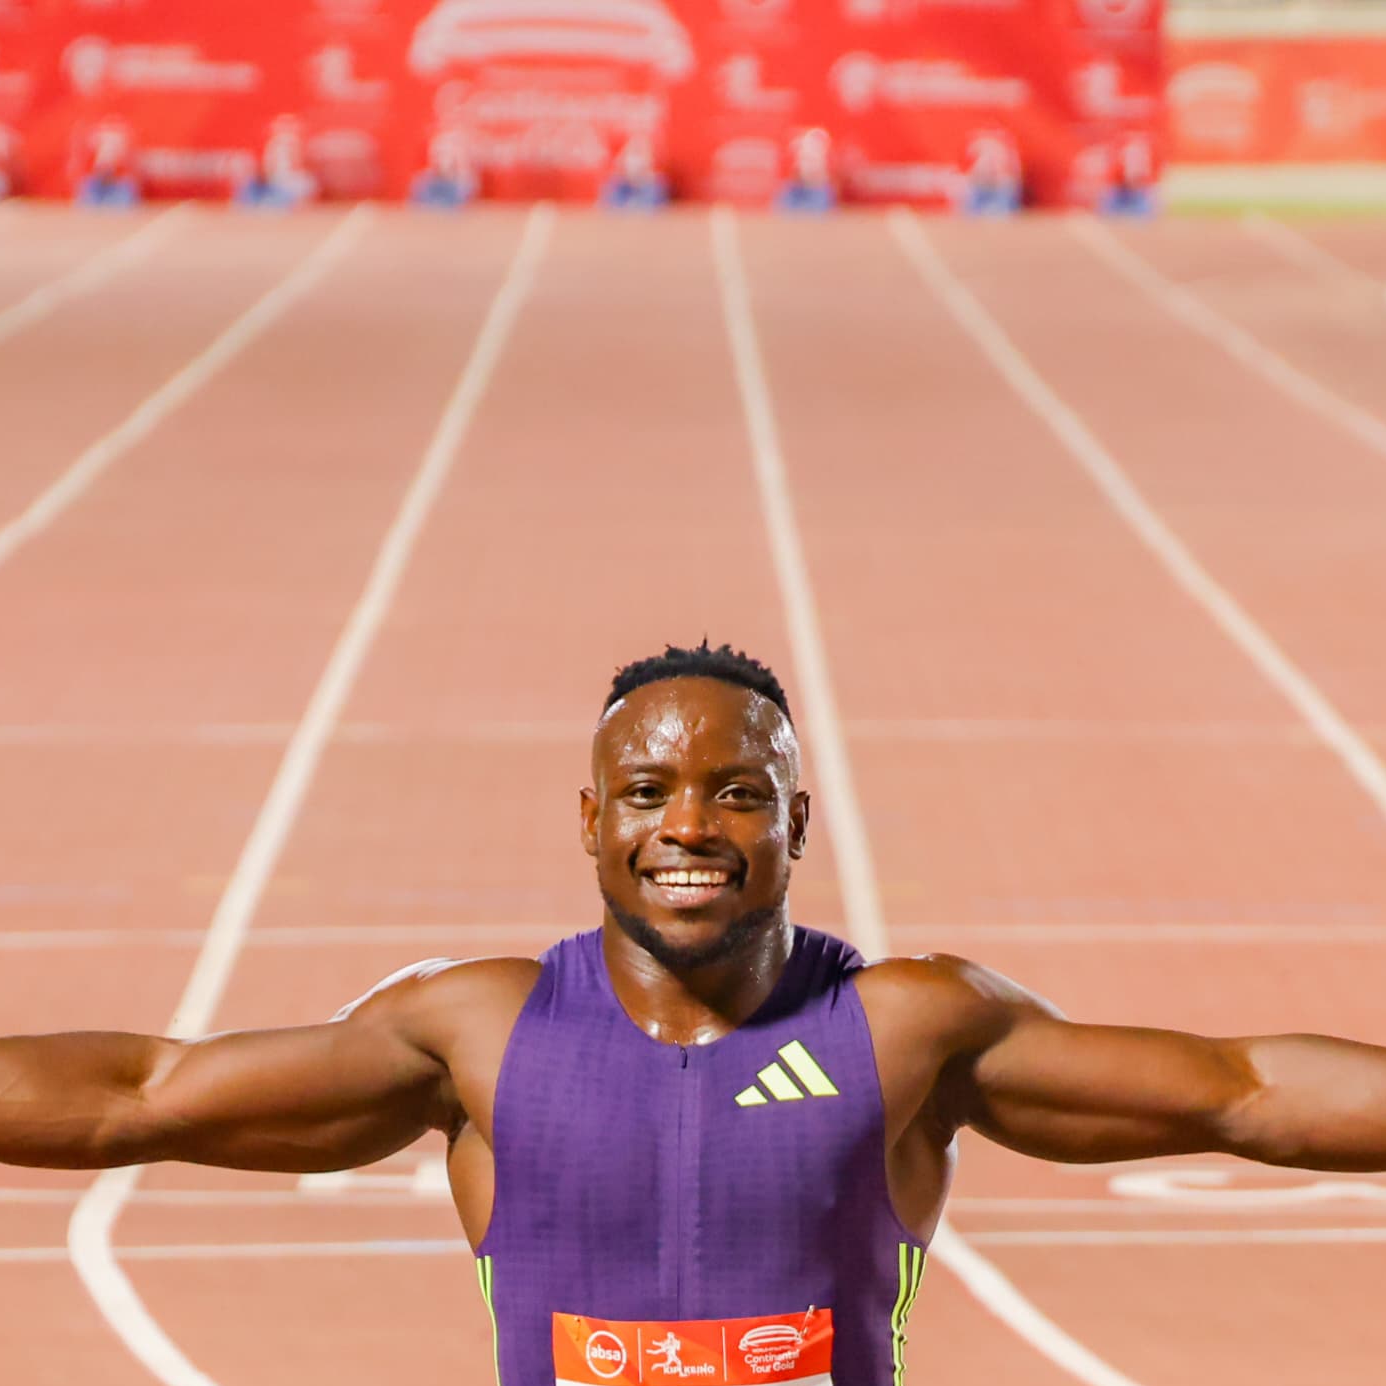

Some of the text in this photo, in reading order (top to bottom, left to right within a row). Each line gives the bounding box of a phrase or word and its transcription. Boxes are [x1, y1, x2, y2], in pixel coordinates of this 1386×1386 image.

[590, 1344, 622, 1361] absa
[744, 1348, 800, 1364] Continental
[750, 1360, 795, 1374] Tour Gold
